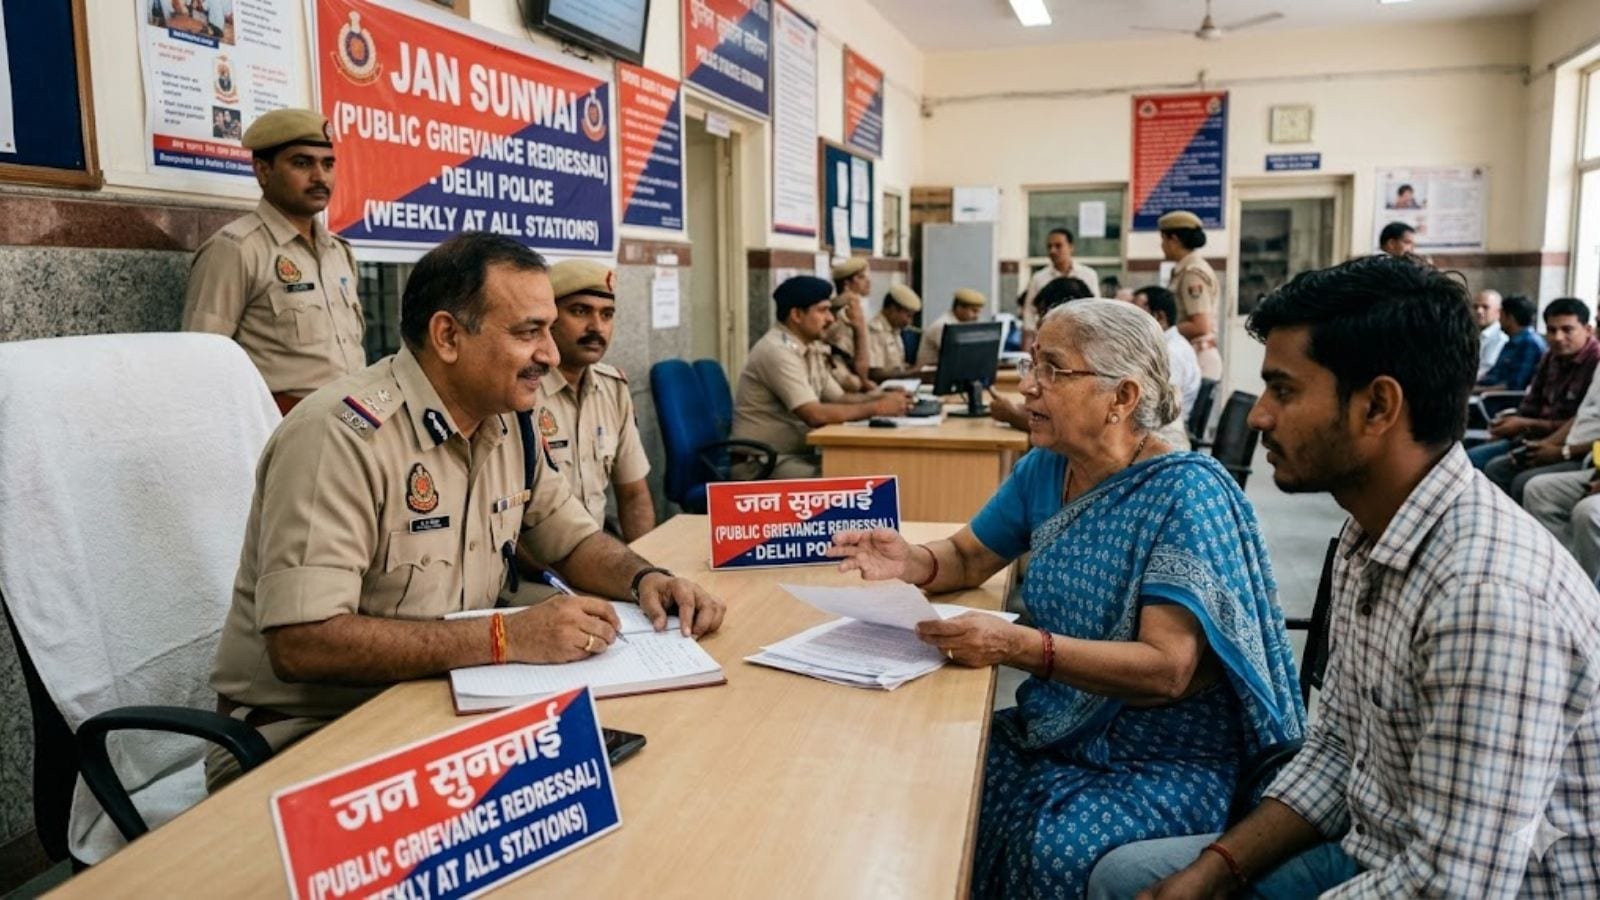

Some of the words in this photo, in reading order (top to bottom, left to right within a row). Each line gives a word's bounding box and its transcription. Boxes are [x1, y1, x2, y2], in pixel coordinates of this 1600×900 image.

[390, 41, 461, 106] JAN
[469, 63, 578, 134] SUNWAI
[333, 100, 420, 148] (PUBLIC
[425, 118, 524, 164] GRIEVANCE
[526, 140, 608, 185] REDRESSAL)
[441, 165, 495, 198] DELHI
[499, 173, 554, 206] POLICE
[364, 198, 458, 233] (WEEKLY
[462, 209, 487, 232] AT
[490, 213, 522, 237] ALL
[525, 215, 599, 245] STATIONS)
[715, 523, 760, 543] (PUBLIC
[763, 520, 826, 539] GRIEVANCE
[734, 492, 782, 513] जन
[787, 480, 874, 520] सुनवाई
[756, 543, 801, 560] DELHI
[329, 769, 419, 831] जन
[425, 701, 561, 808] सुनवाई
[308, 846, 393, 900] (PUBLIC
[394, 804, 500, 869] GRIEVANCE
[503, 758, 601, 822] REDRESSAL)
[437, 858, 462, 892] AT
[465, 844, 499, 883] ALL
[501, 802, 588, 865] STATIONS)
